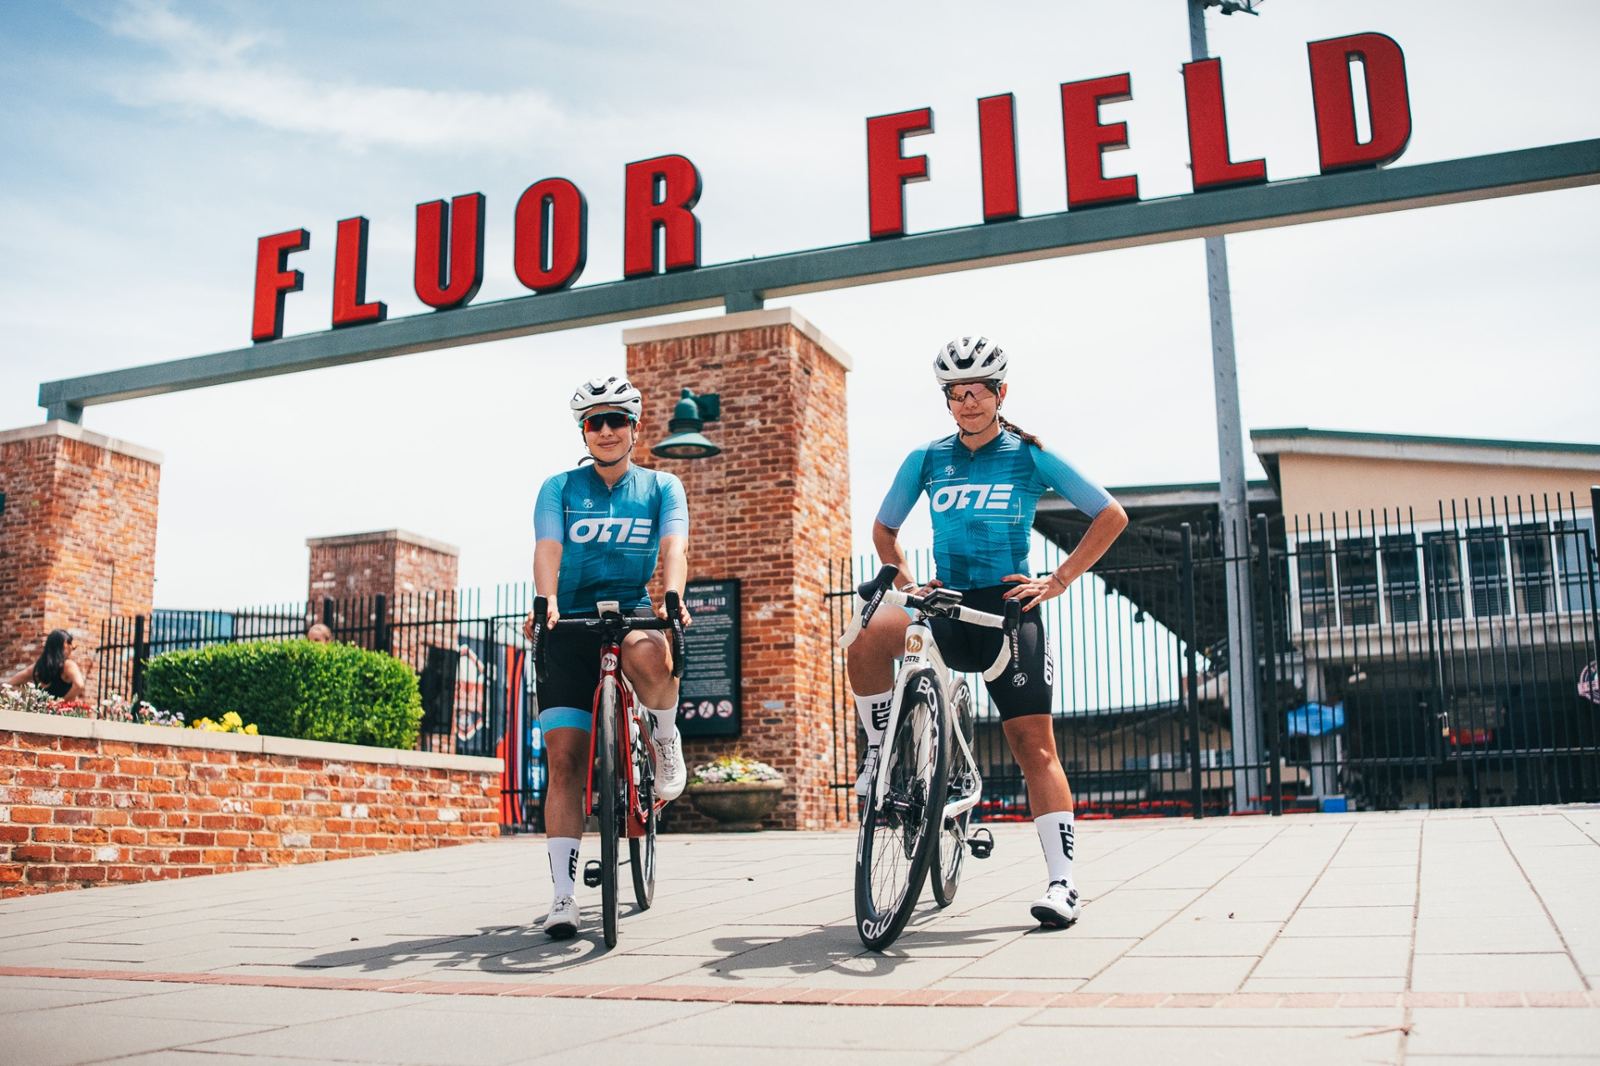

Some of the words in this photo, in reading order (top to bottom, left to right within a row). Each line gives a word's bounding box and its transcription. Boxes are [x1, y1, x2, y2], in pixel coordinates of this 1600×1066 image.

[252, 154, 703, 343] FLUOR
[866, 31, 1413, 241] FIELD
[932, 484, 1014, 513] ONE
[569, 517, 653, 544] ONE
